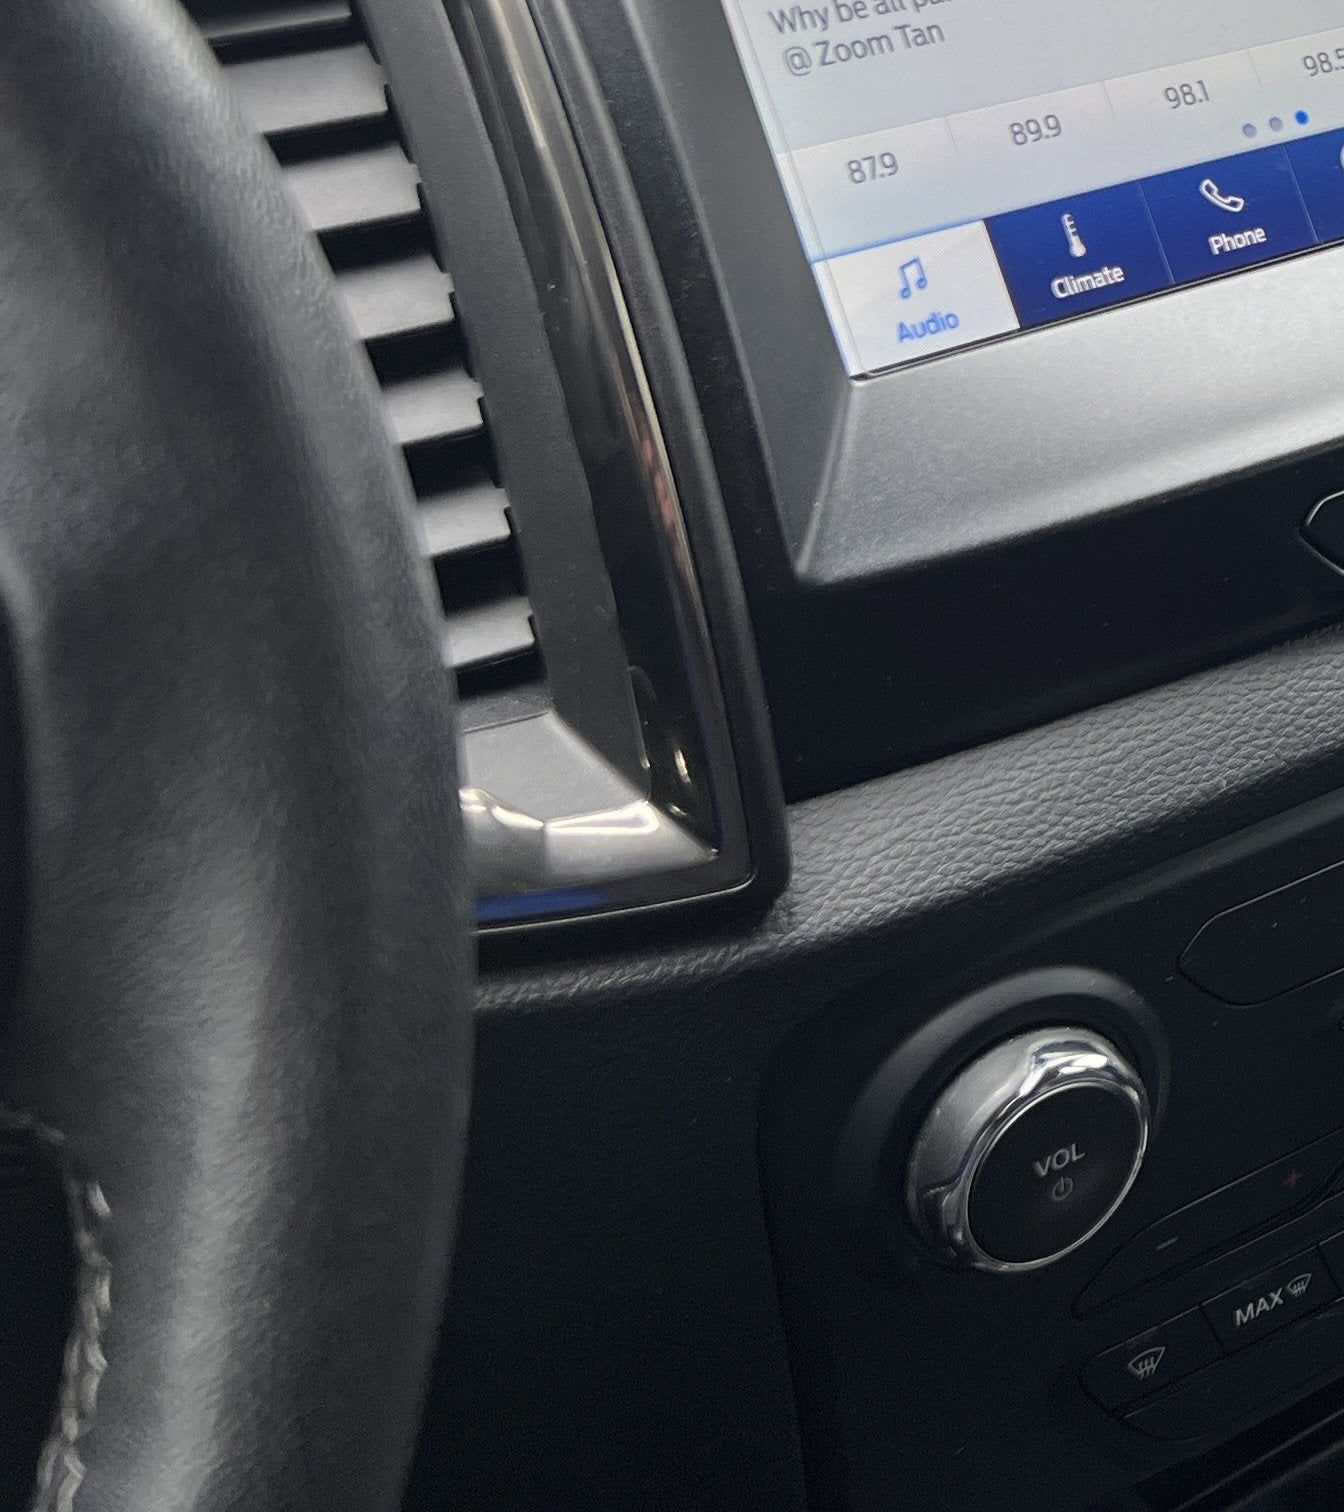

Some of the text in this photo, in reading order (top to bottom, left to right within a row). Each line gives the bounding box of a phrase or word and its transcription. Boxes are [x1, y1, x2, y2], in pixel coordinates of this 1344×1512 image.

[767, 5, 830, 35] Why
[782, 22, 946, 77] @ Zoom Tan
[847, 151, 899, 184] 87.9
[1009, 113, 1063, 146] 89.9
[1164, 80, 1211, 110] 98.1
[1208, 224, 1268, 256] Phone
[1050, 266, 1126, 300] Climate
[895, 310, 960, 344] Audio
[1034, 1143, 1086, 1177] VOL
[1234, 1287, 1284, 1326] MAX
